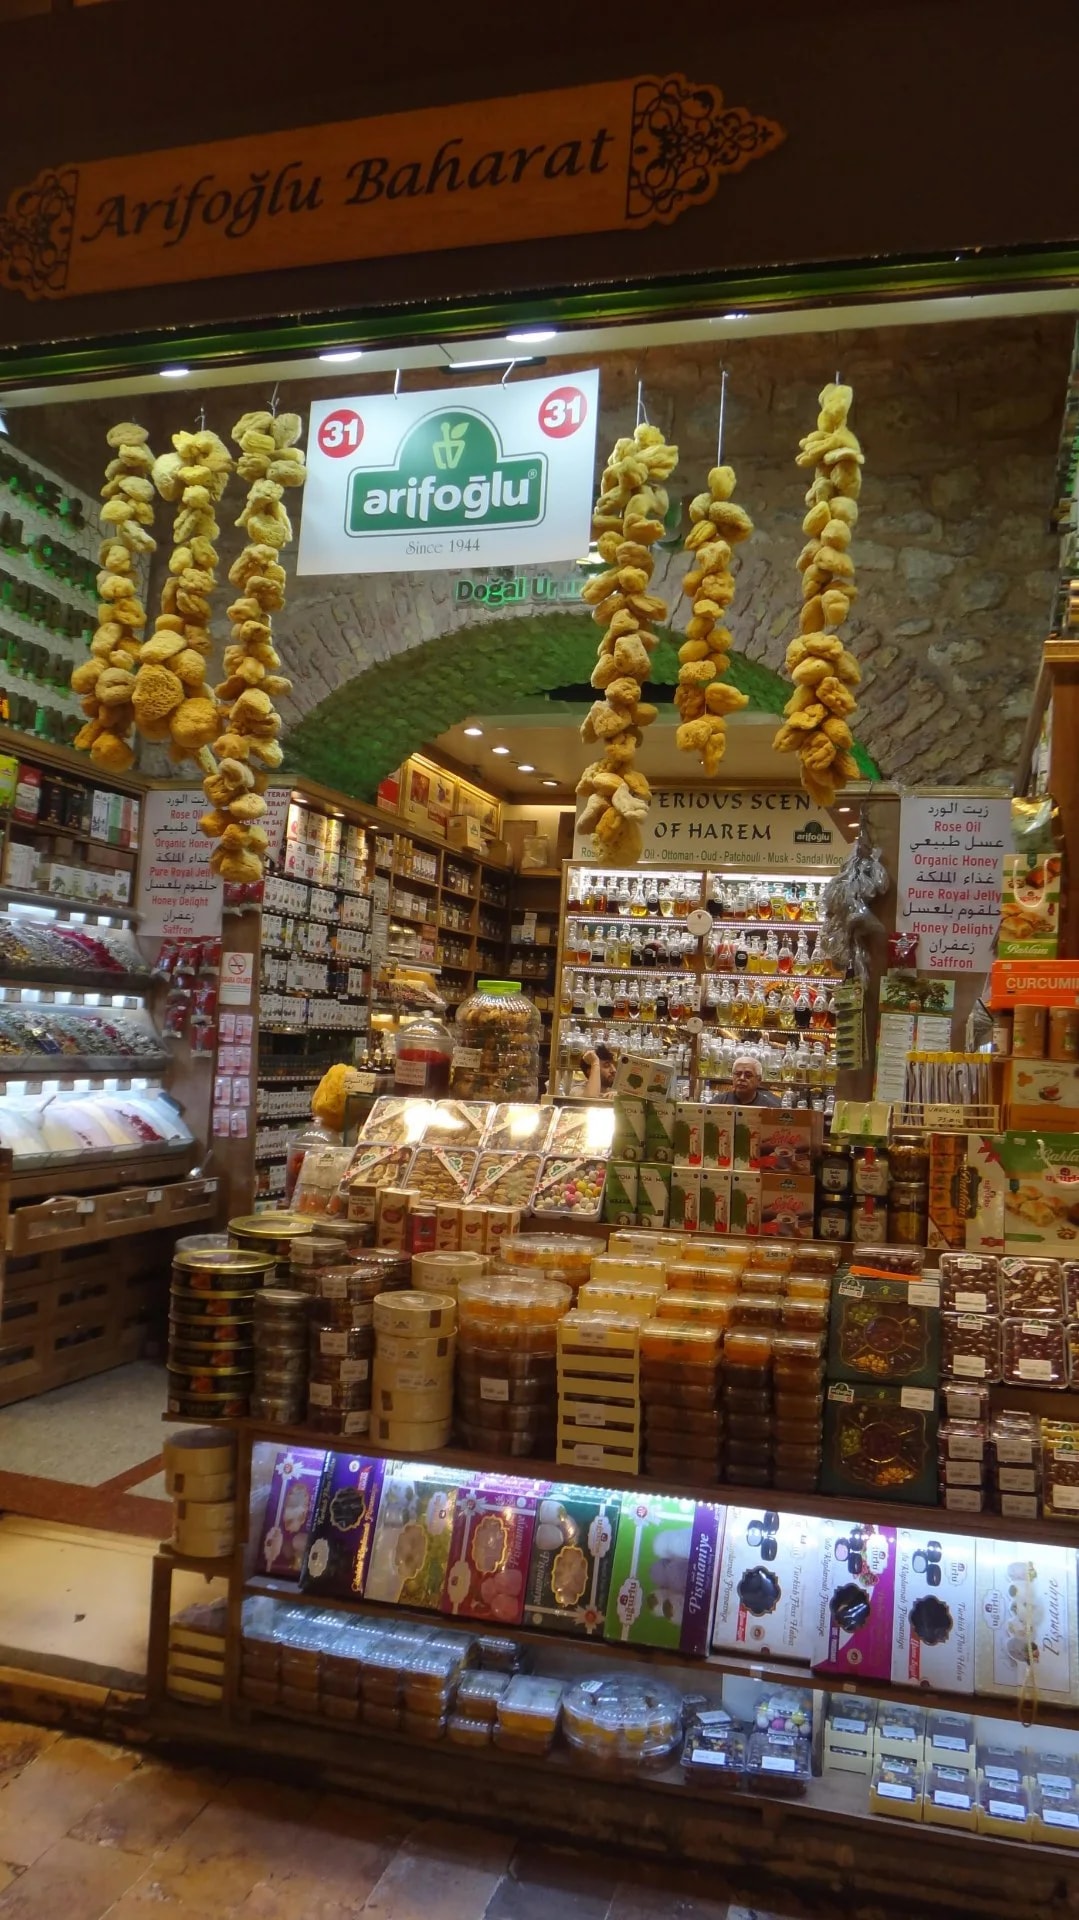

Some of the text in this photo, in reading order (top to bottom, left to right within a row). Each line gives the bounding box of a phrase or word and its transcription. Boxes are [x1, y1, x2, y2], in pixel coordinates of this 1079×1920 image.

[81, 126, 610, 248] Arifoğlu Baharat
[544, 396, 580, 428] 31
[322, 418, 360, 448] 31
[363, 471, 530, 522] arifoğlu
[406, 538, 480, 555] Since 1944
[457, 577, 525, 603] Doğal
[751, 793, 822, 810] SCEN
[171, 810, 190, 819] Rose
[928, 802, 989, 818] زيت الورد
[654, 822, 771, 840] OF HAREM
[934, 821, 981, 832] Rose Oil
[155, 838, 214, 849] Organic Honey
[909, 835, 1004, 852] عسل طبيعي
[661, 849, 694, 861] Ottoman
[701, 851, 717, 861] Oud
[724, 851, 760, 863] Patchouli
[768, 852, 789, 863] Musk
[796, 853, 823, 864] Sandal
[826, 854, 844, 865] Woo
[914, 854, 999, 869] Organic Honey
[150, 866, 168, 876] Pure
[171, 867, 192, 878] Royal
[916, 870, 995, 885] غذاء الملكة
[152, 895, 208, 907] Honey Delight
[908, 887, 934, 899] Pure
[938, 888, 969, 902] Royal
[974, 889, 1001, 903] Jelly
[162, 909, 195, 923] زعفران
[163, 925, 192, 934] Saffron
[912, 921, 993, 937] Honey Delight
[929, 938, 975, 954] زعفران
[929, 955, 973, 968] Saffron
[689, 1533, 713, 1614] Pişmaniye
[791, 1565, 802, 1597] Turkish
[957, 1602, 966, 1631] Turkish
[1042, 1578, 1065, 1657] Pişmaniye
